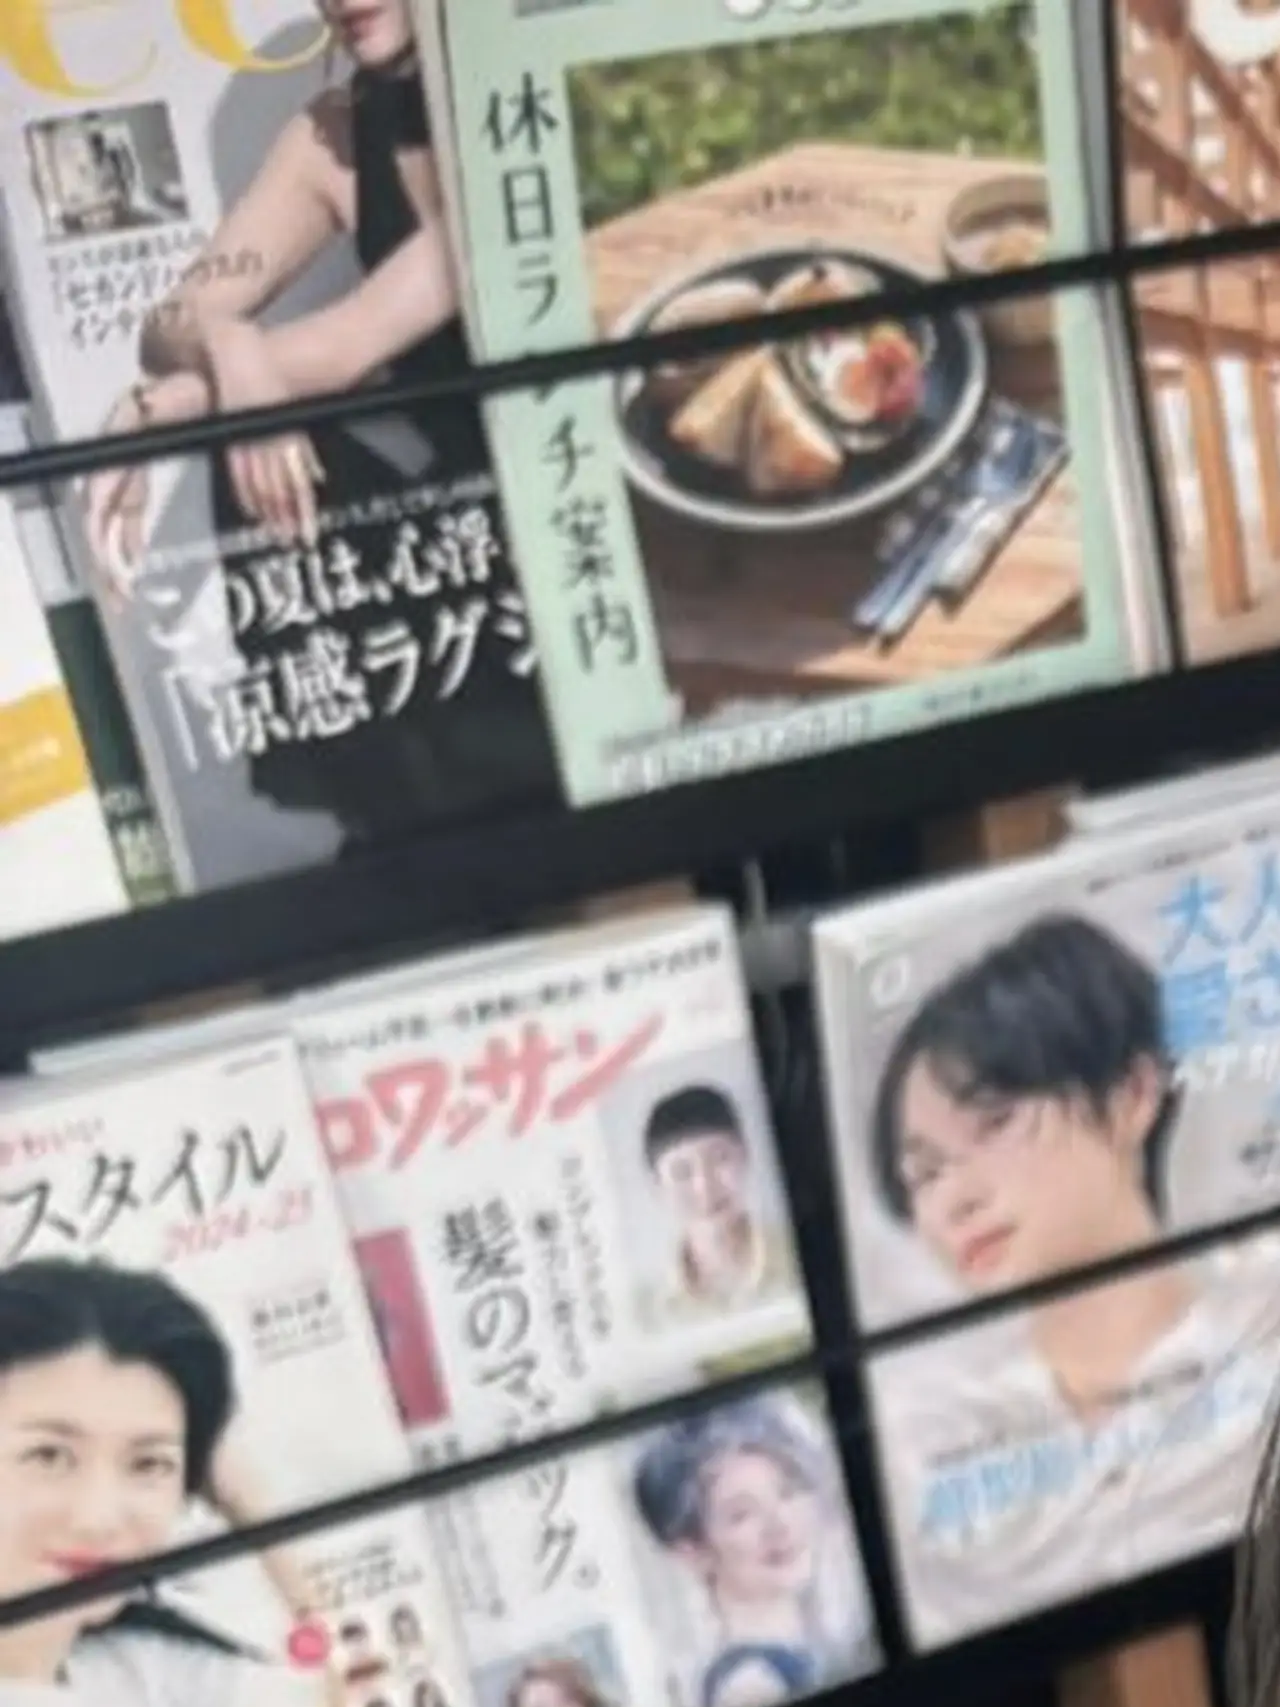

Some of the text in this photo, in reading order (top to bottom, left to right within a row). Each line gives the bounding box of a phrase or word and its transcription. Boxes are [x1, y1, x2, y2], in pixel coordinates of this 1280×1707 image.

[480, 69, 640, 673] 休日ラチ案内
